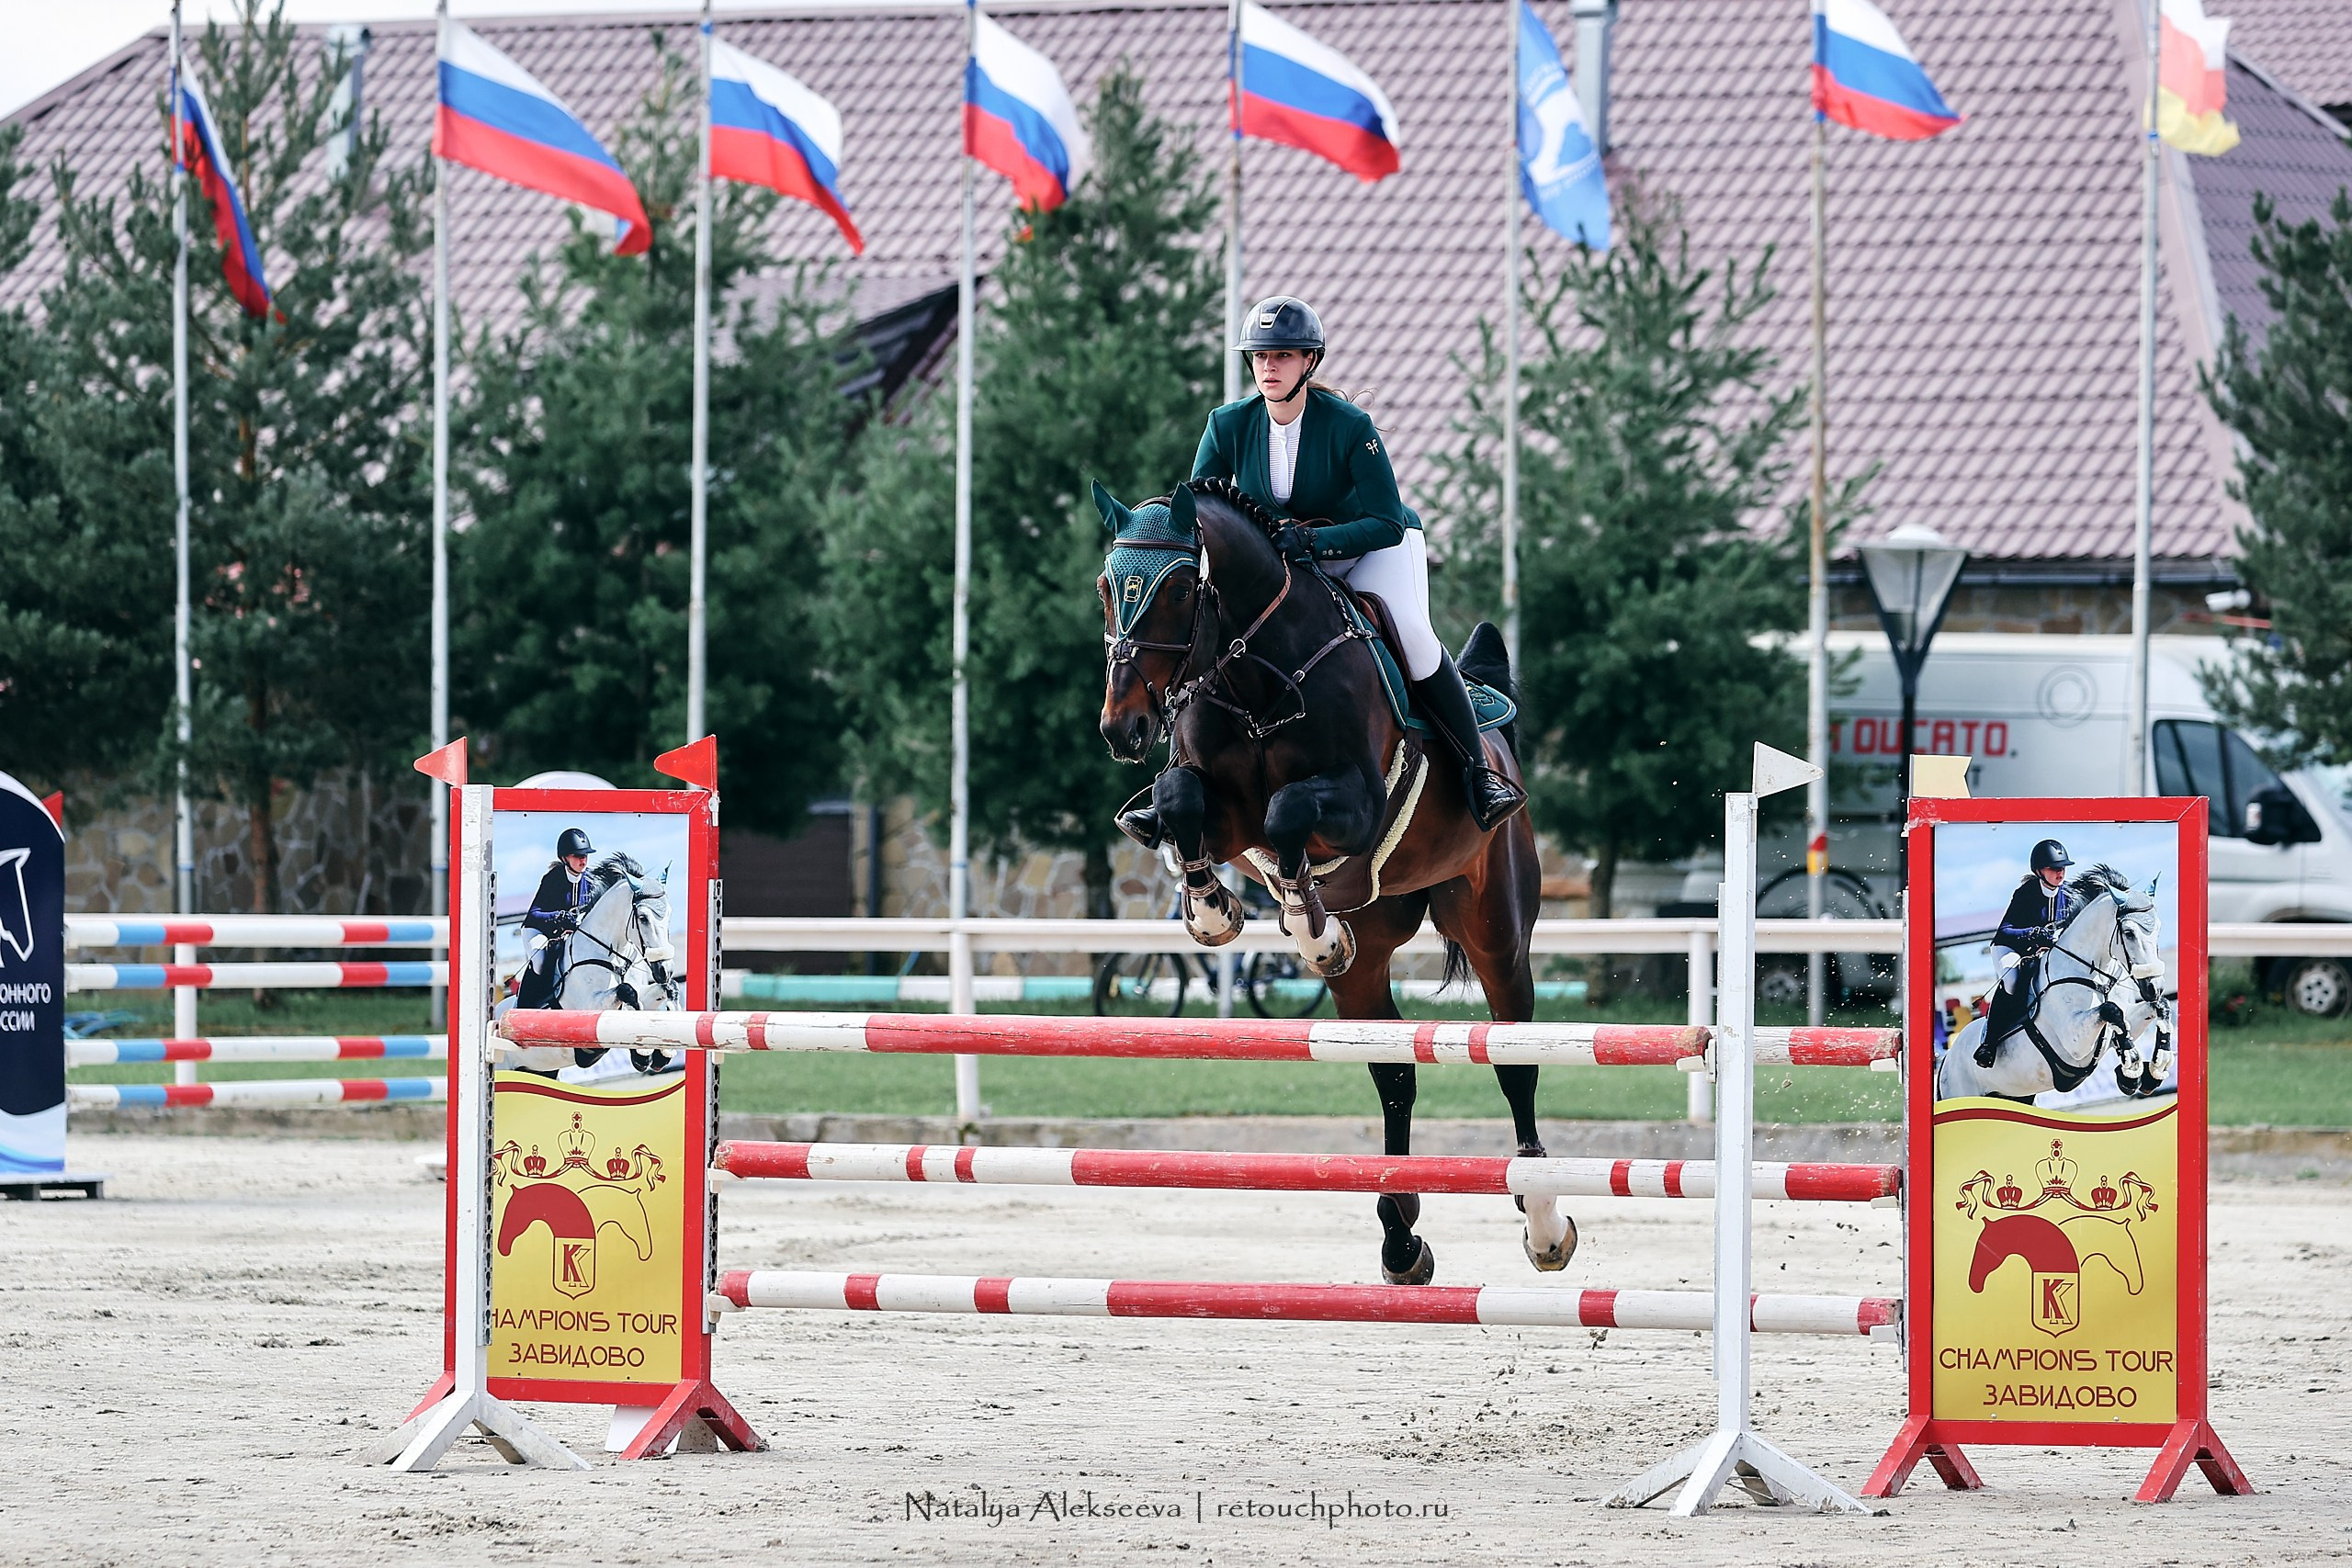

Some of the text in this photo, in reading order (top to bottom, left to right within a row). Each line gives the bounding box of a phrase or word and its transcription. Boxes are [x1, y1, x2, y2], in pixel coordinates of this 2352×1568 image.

[0, 983, 51, 1004] ОННОГО
[0, 1010, 35, 1032] ССИИ
[492, 1308, 677, 1336] HAMPIONS TOUR
[508, 1342, 645, 1369] ЗАВИДОВО
[1939, 1348, 2174, 1372] CHAMPIONS TOUR
[1983, 1384, 2137, 1410] ЗАВИДОВО
